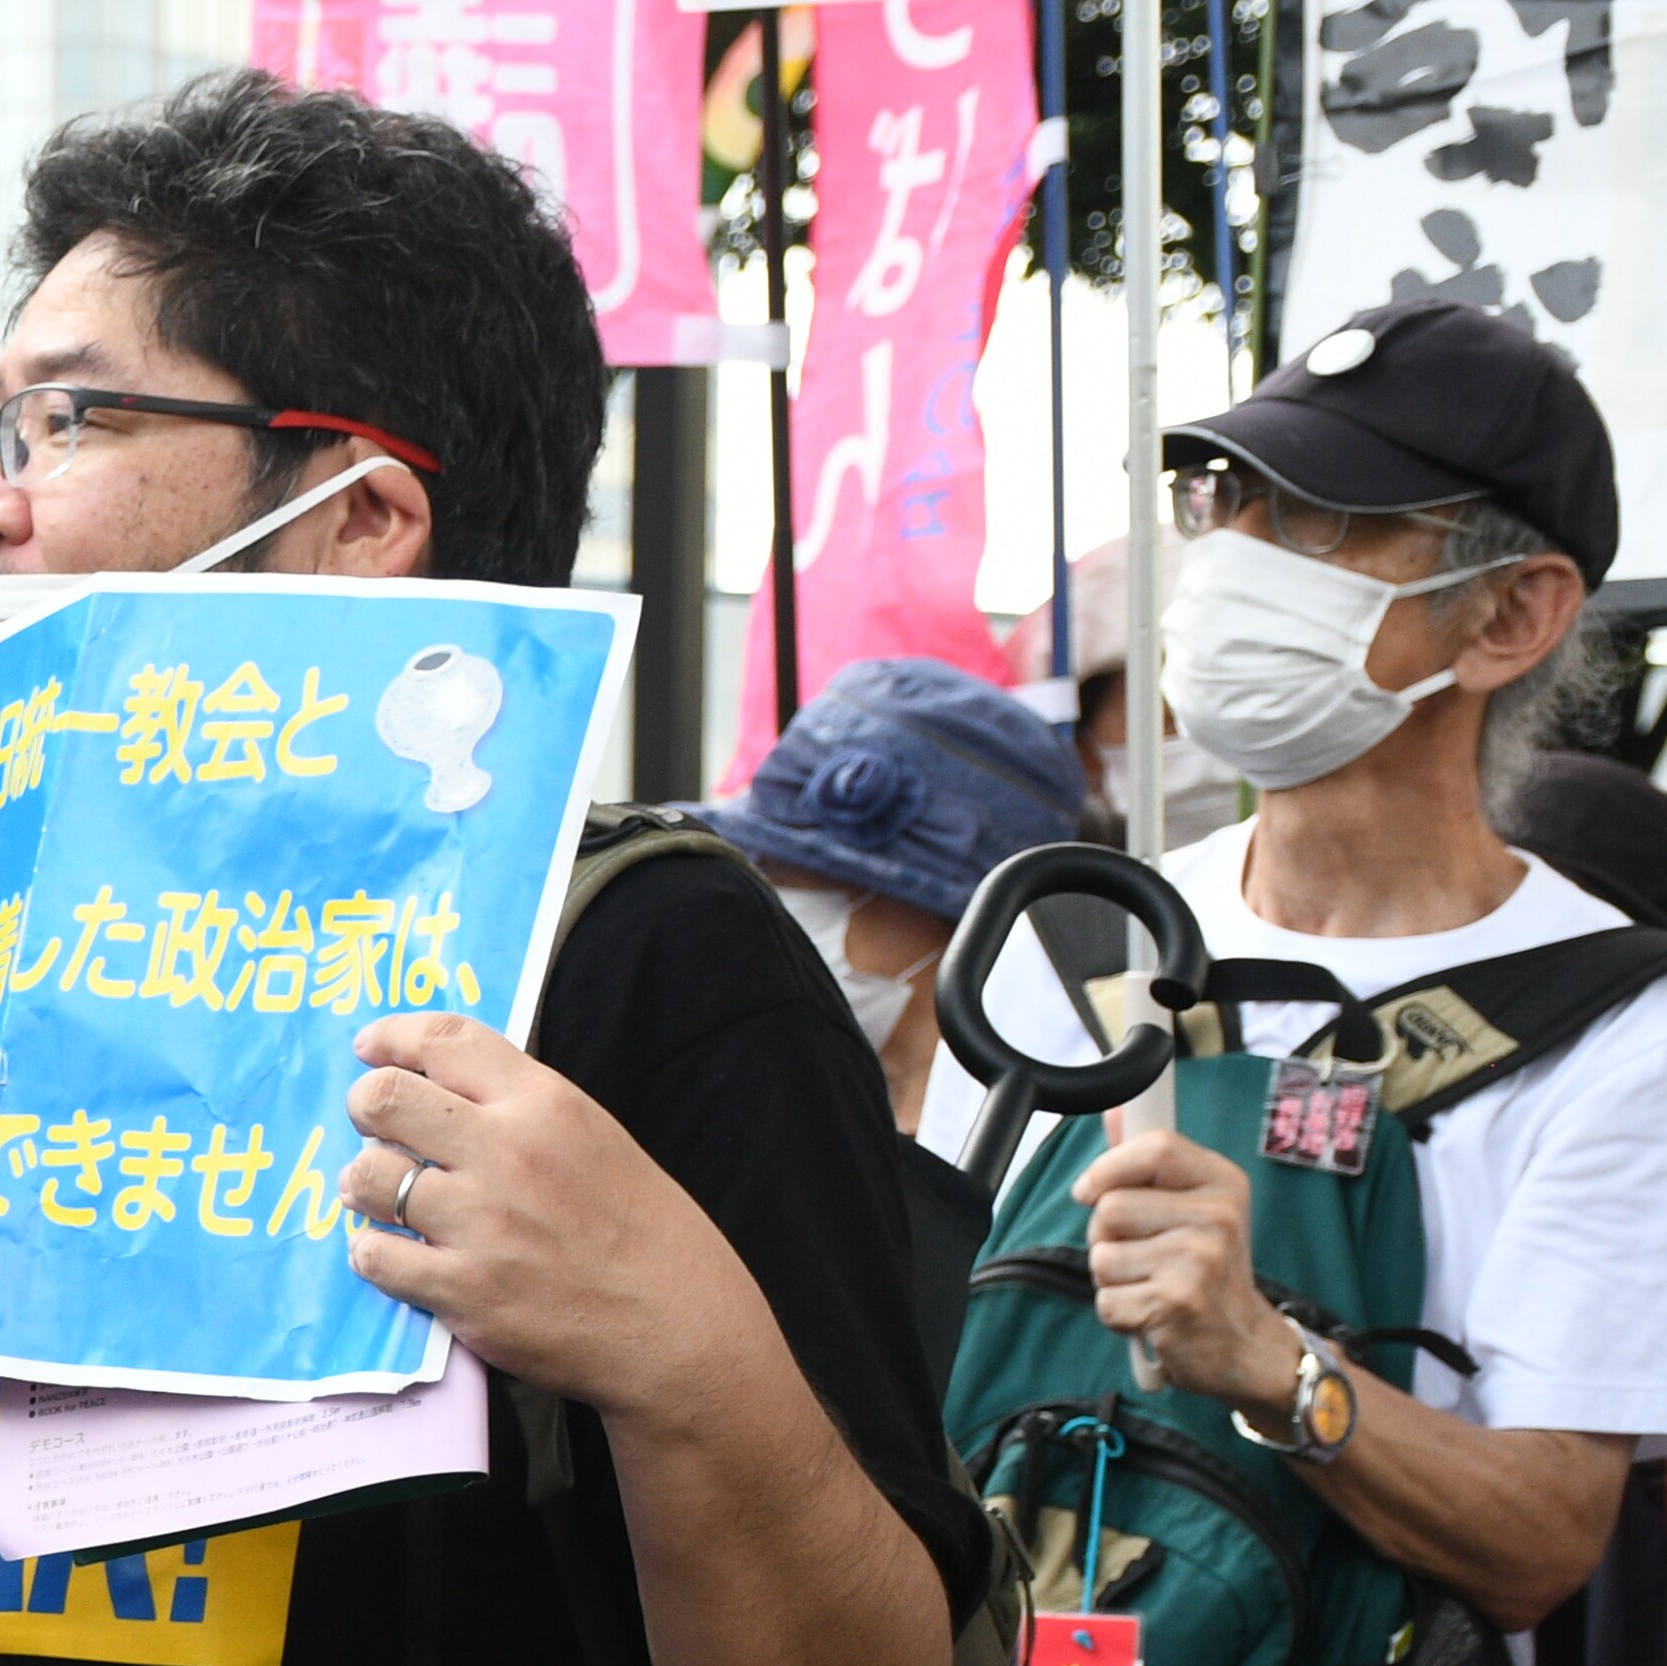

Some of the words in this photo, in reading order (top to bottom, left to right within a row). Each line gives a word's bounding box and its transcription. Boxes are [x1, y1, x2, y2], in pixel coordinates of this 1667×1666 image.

[29, 1432, 86, 1454] デモコース
